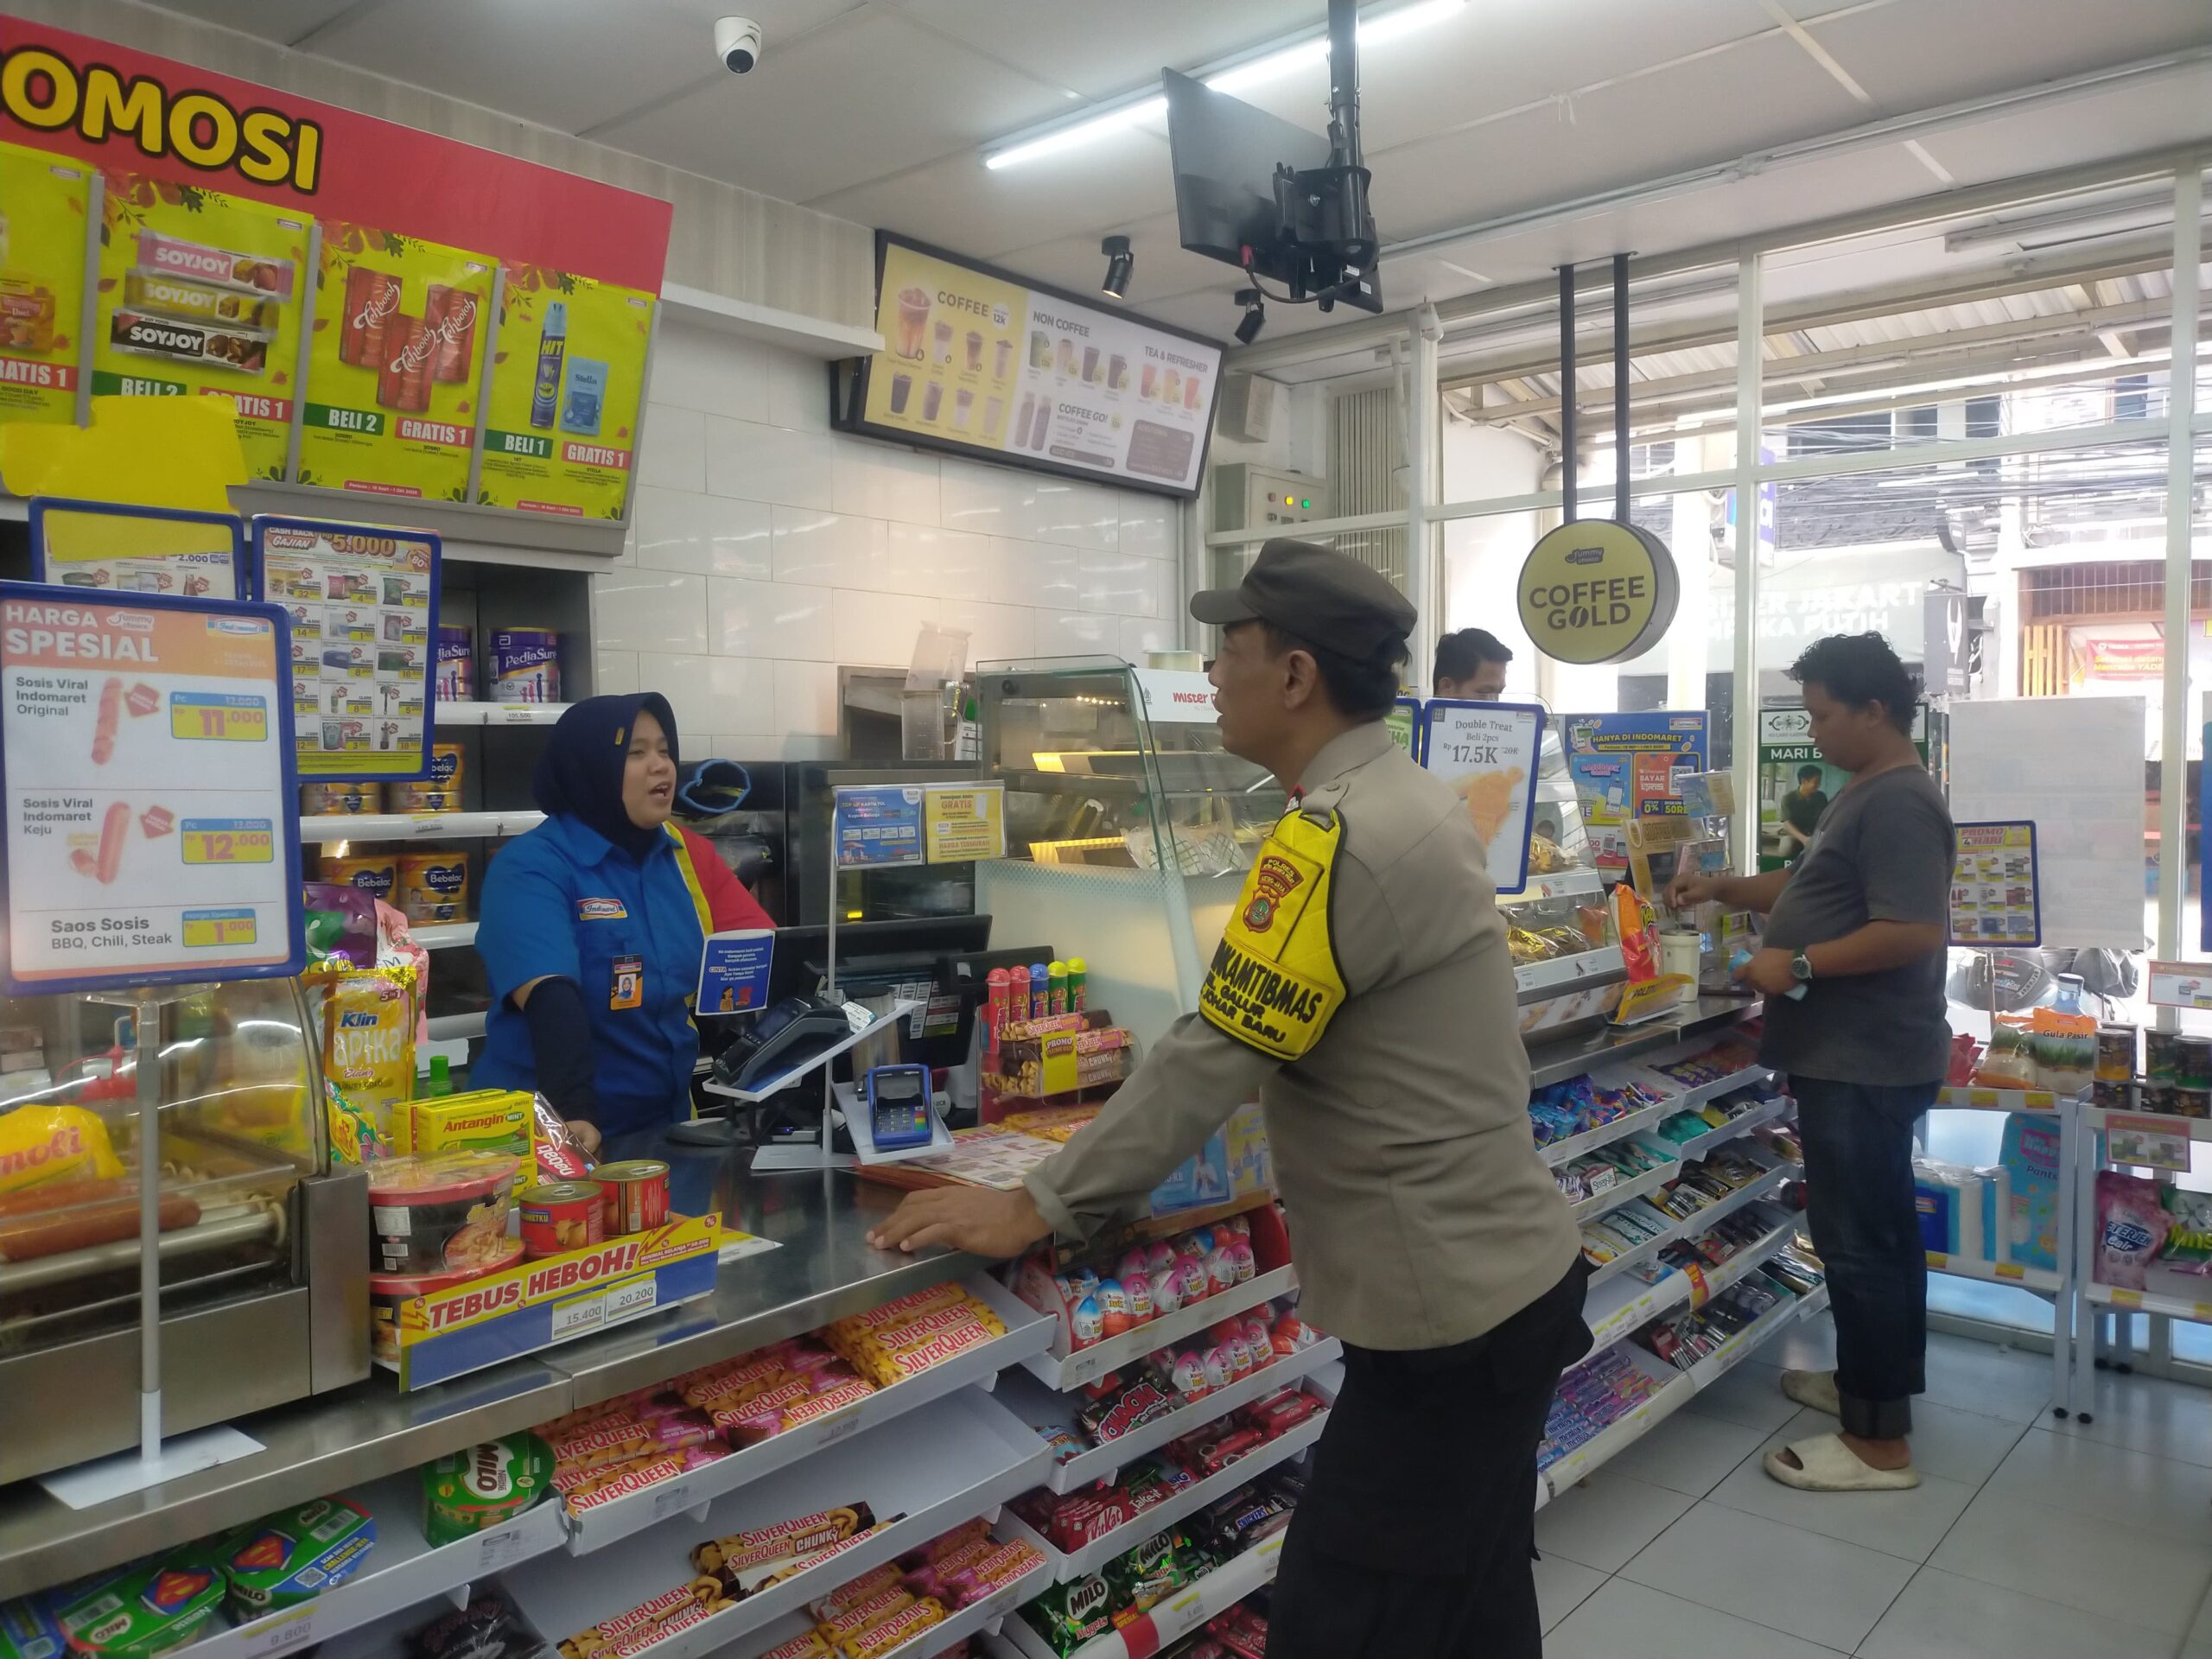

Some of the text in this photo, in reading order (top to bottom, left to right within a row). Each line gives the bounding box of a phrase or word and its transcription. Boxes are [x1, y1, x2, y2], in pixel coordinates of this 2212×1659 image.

[155, 247, 230, 275] SOYJOY
[145, 282, 215, 308] SOYJOY
[938, 291, 990, 318] COFFEE
[1033, 311, 1090, 338] NON COFFEE
[130, 327, 202, 350] SOYJOY
[541, 340, 564, 355] HIT
[1144, 346, 1158, 359] TEA
[1166, 353, 1209, 374] REFRESHER
[56, 368, 67, 387] 1
[168, 385, 178, 396] 2
[207, 391, 283, 419] ATIS 1
[1058, 403, 1109, 423] COFFEE GO!
[328, 409, 467, 445] BELI 2 GRATIS 1
[505, 435, 625, 467] BELI 1 GRATIS 1
[1529, 575, 1645, 609] COFFEE
[6, 605, 99, 628] HARGA
[1548, 603, 1630, 630] GOLD
[1804, 610, 1890, 634] PUTIH
[5, 628, 159, 663] SPESIAL
[505, 648, 557, 669] PediaSure
[16, 677, 88, 690] Sosis Viral
[16, 690, 86, 703] Indomaret
[1173, 692, 1208, 704] Mister
[17, 704, 69, 718] Original
[1456, 719, 1513, 732] Double Treat
[1466, 732, 1499, 743] Beli 2pcs
[1592, 734, 1621, 743] HANYA
[1632, 733, 1683, 742] INDOMARET
[1452, 744, 1498, 764] 17.5K
[1771, 747, 1808, 760] MARI
[23, 798, 93, 809] Sosis Viral
[941, 799, 972, 810] GRATIS
[23, 811, 92, 823] Indomaret
[23, 824, 52, 836] Keju
[1961, 827, 2005, 836] PROMO
[1973, 836, 2004, 845] HARI
[51, 916, 149, 933] Saos Sosis
[52, 933, 172, 950] BBQ, Chili, Steak
[340, 1011, 379, 1028] Klin
[1046, 1036, 1073, 1047] PROMO
[2043, 1029, 2088, 1040] Gula Pasir
[442, 1112, 524, 1134] Antangin MINT
[2026, 1166, 2058, 1181] Pants
[429, 1243, 640, 1329] TEBUS HEBOH!
[619, 1286, 654, 1306] 20.200
[565, 1305, 602, 1325] 15.400
[863, 1285, 953, 1328] SILVERQUEEN
[876, 1303, 977, 1350] SILVERQUEEN
[893, 1319, 995, 1376] SILVERQUEEN
[692, 1359, 785, 1404] SILVERQUEEN
[715, 1381, 810, 1427] SILVERQUEEN
[1558, 1426, 1582, 1442] mentos
[1566, 1432, 1590, 1448] mentos
[477, 1443, 499, 1491] MILO
[568, 1459, 682, 1512] SILVERQUEEN
[740, 1511, 829, 1548] SILVERQUEEN
[731, 1526, 841, 1569] SILVERQUEEN CHUNKY
[1138, 1532, 1171, 1565] MILO
[1070, 1580, 1106, 1616] MILO
[597, 1585, 694, 1639] SILVERQUEEN
[831, 1586, 906, 1633] SILVERQUEEN
[1076, 1617, 1109, 1640] Nuggets
